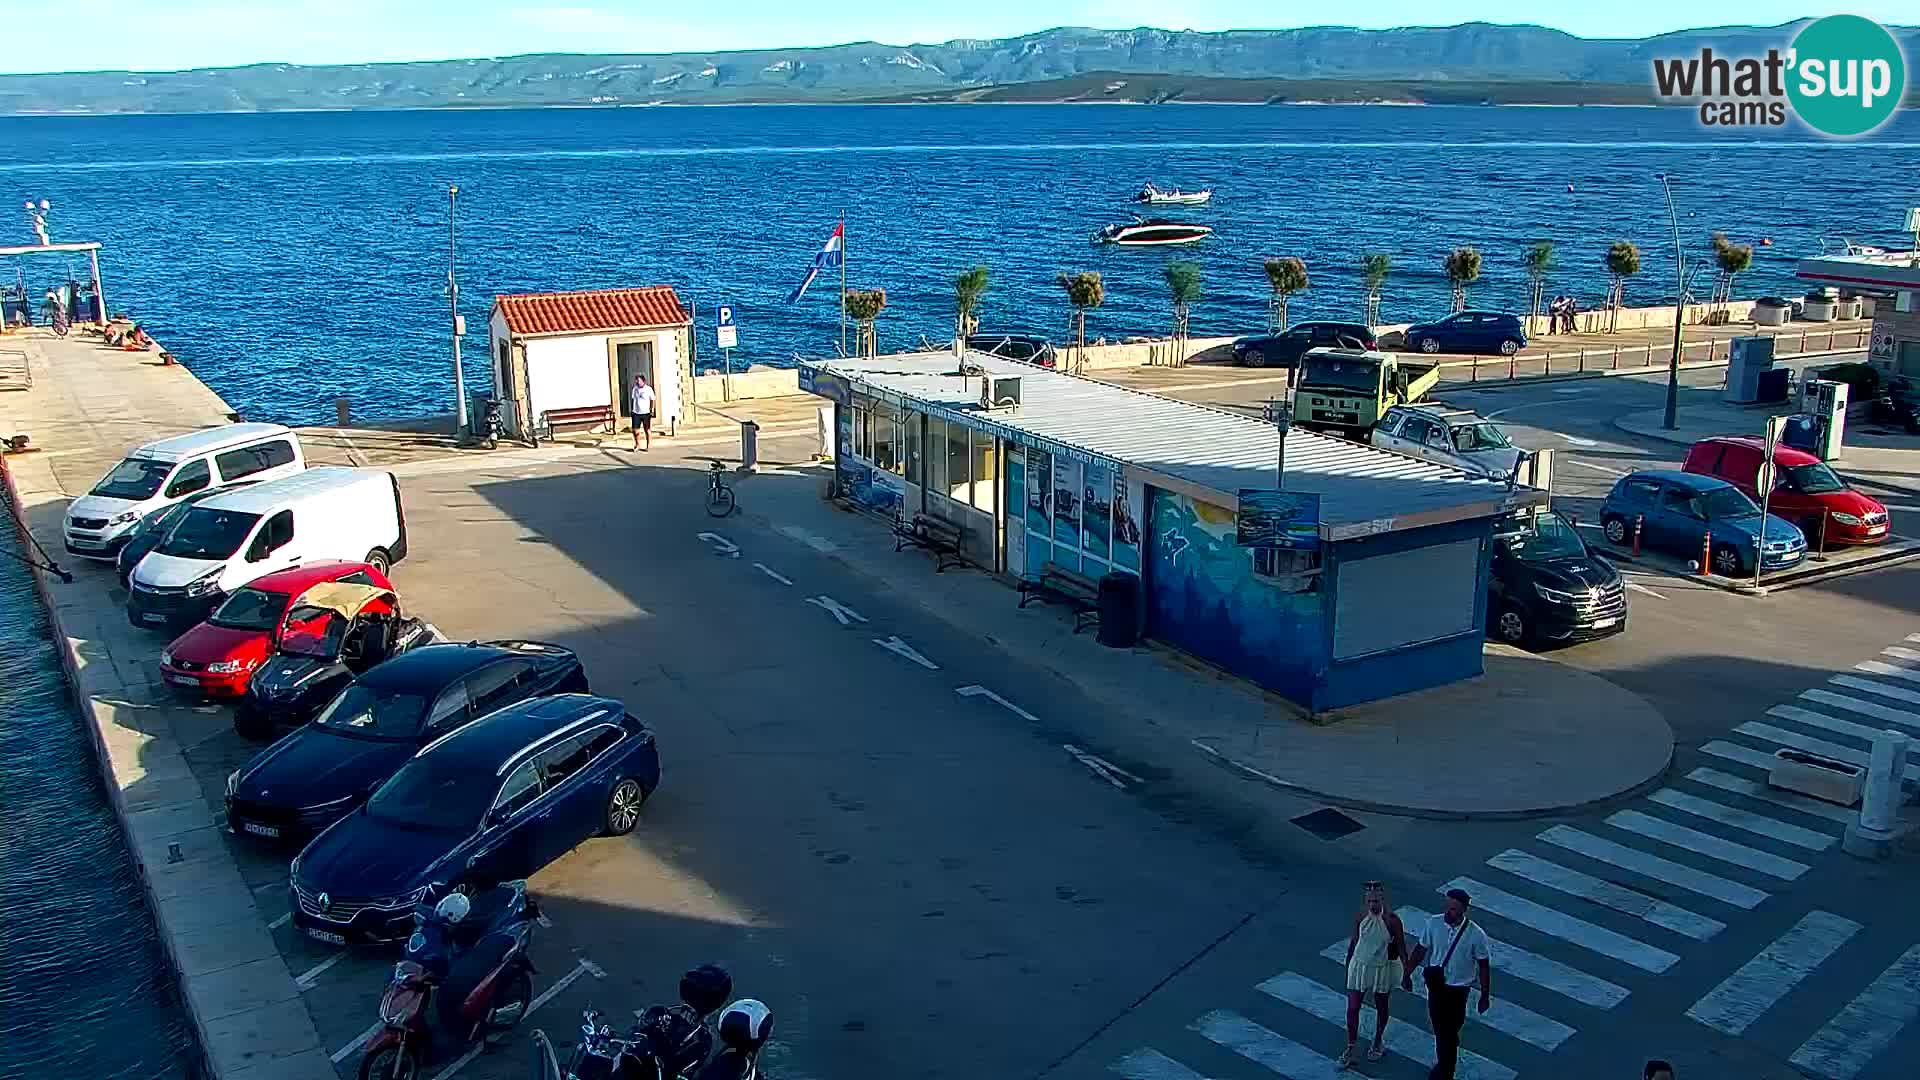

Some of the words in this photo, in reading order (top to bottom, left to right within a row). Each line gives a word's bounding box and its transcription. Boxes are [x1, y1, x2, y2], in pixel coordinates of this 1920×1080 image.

[720, 307, 732, 325] P
[1068, 447, 1092, 464] TICKET
[1093, 457, 1119, 473] OFFICE
